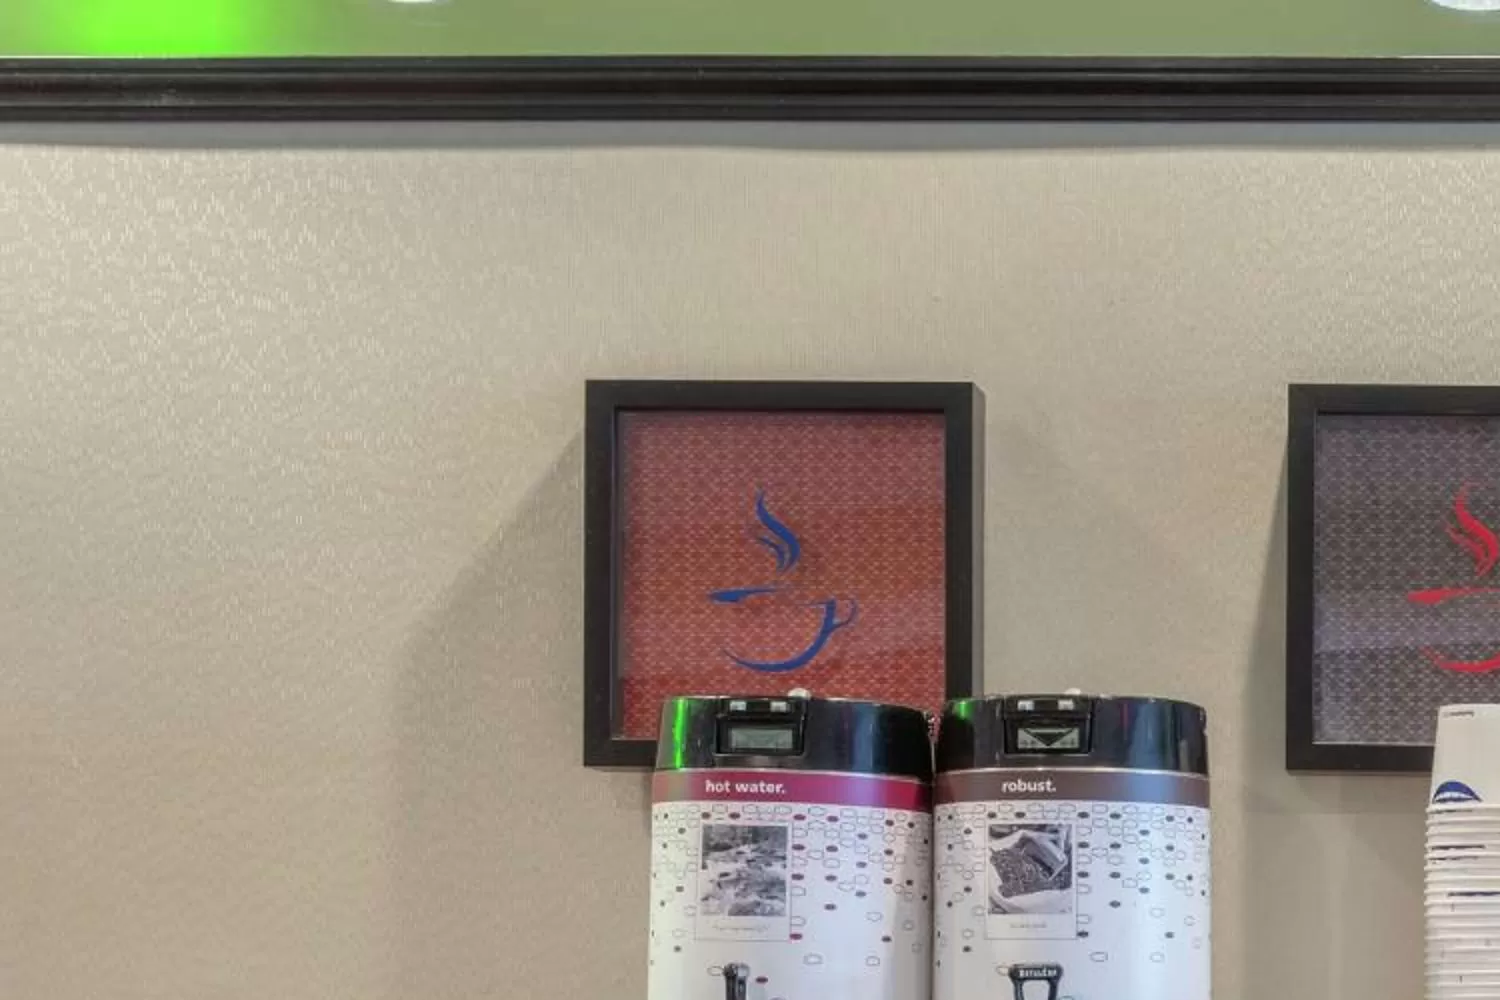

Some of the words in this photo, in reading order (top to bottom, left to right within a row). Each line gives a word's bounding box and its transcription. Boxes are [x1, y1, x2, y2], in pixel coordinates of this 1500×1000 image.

[705, 779, 731, 793] hot
[735, 780, 785, 794] water.
[1001, 778, 1057, 793] robust.
